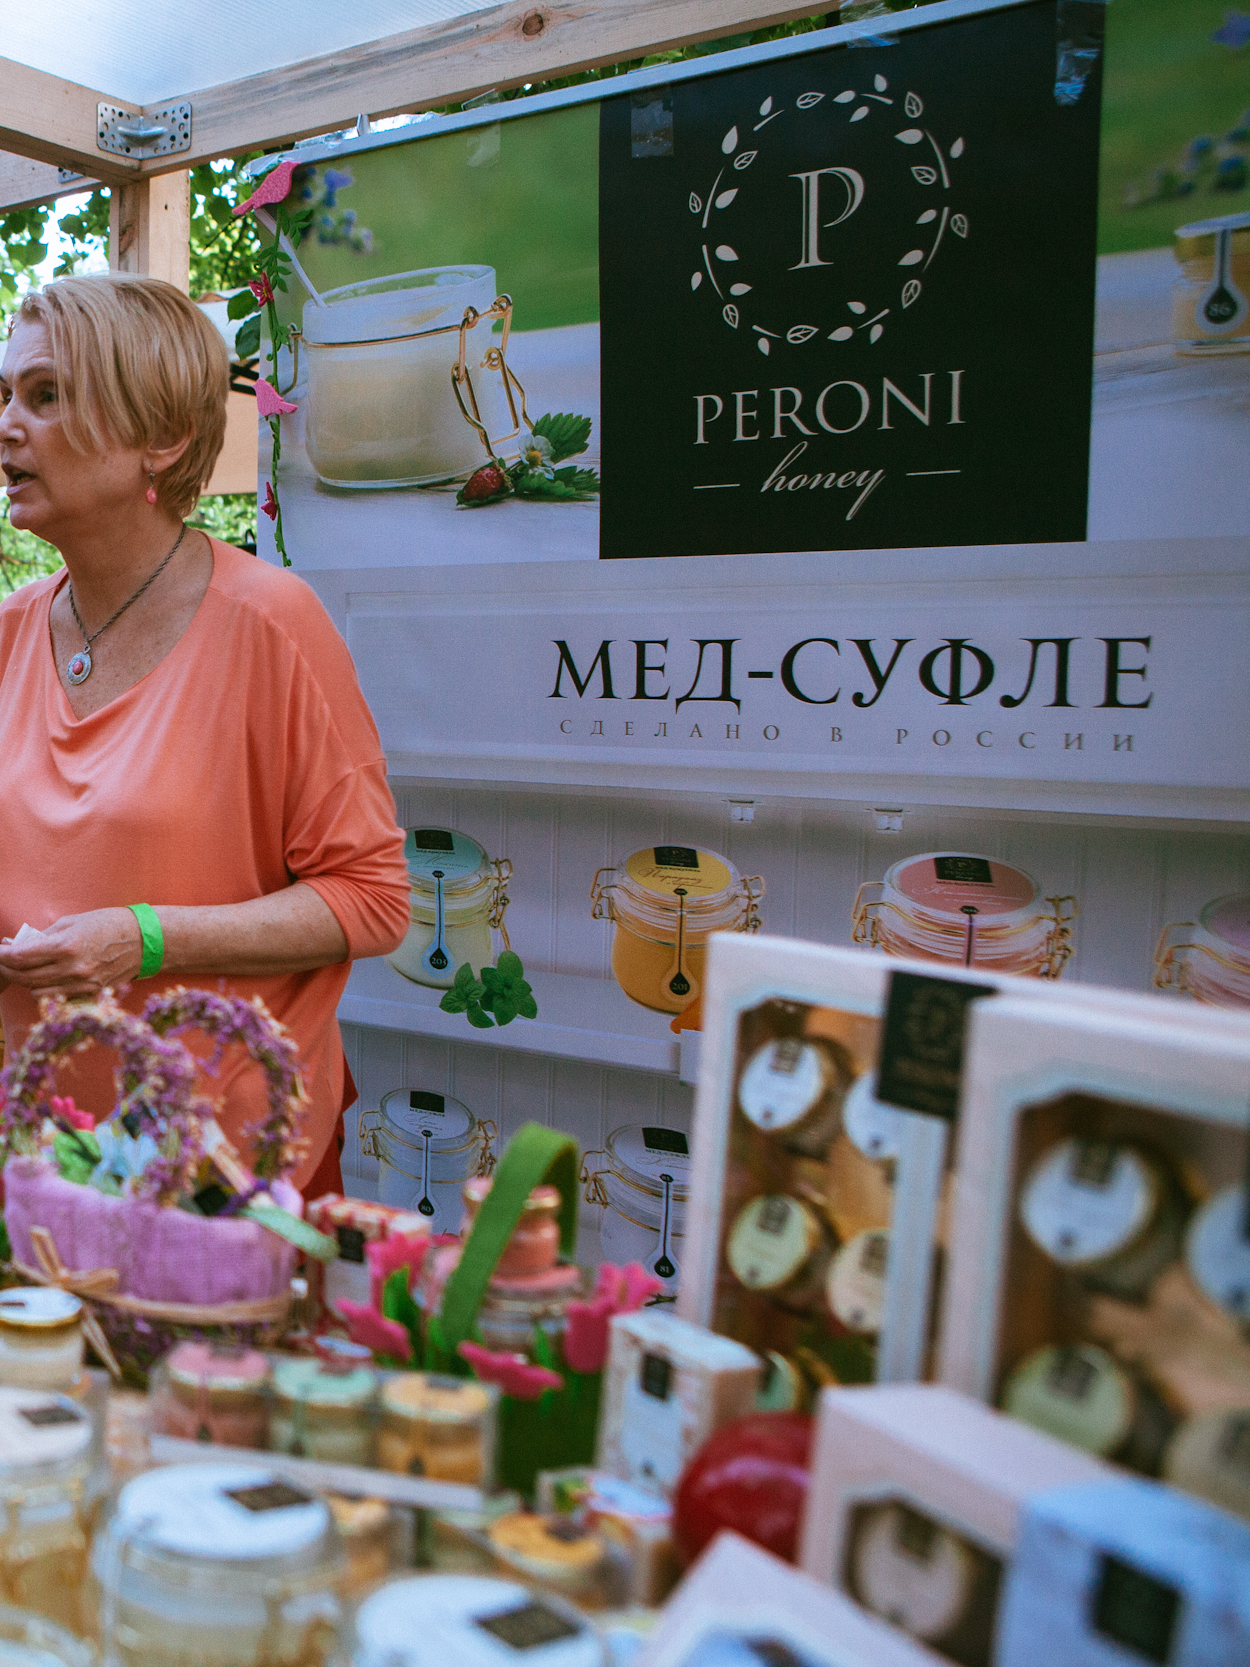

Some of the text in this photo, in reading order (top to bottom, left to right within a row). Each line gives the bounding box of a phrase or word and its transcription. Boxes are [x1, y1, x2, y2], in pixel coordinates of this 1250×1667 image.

[787, 166, 865, 271] P
[692, 369, 966, 445] PERONI
[760, 441, 886, 521] honey
[546, 636, 1154, 716] МЕД-СУФЛЕ
[559, 719, 1134, 752] СДЕЛАНО В РОССИИ
